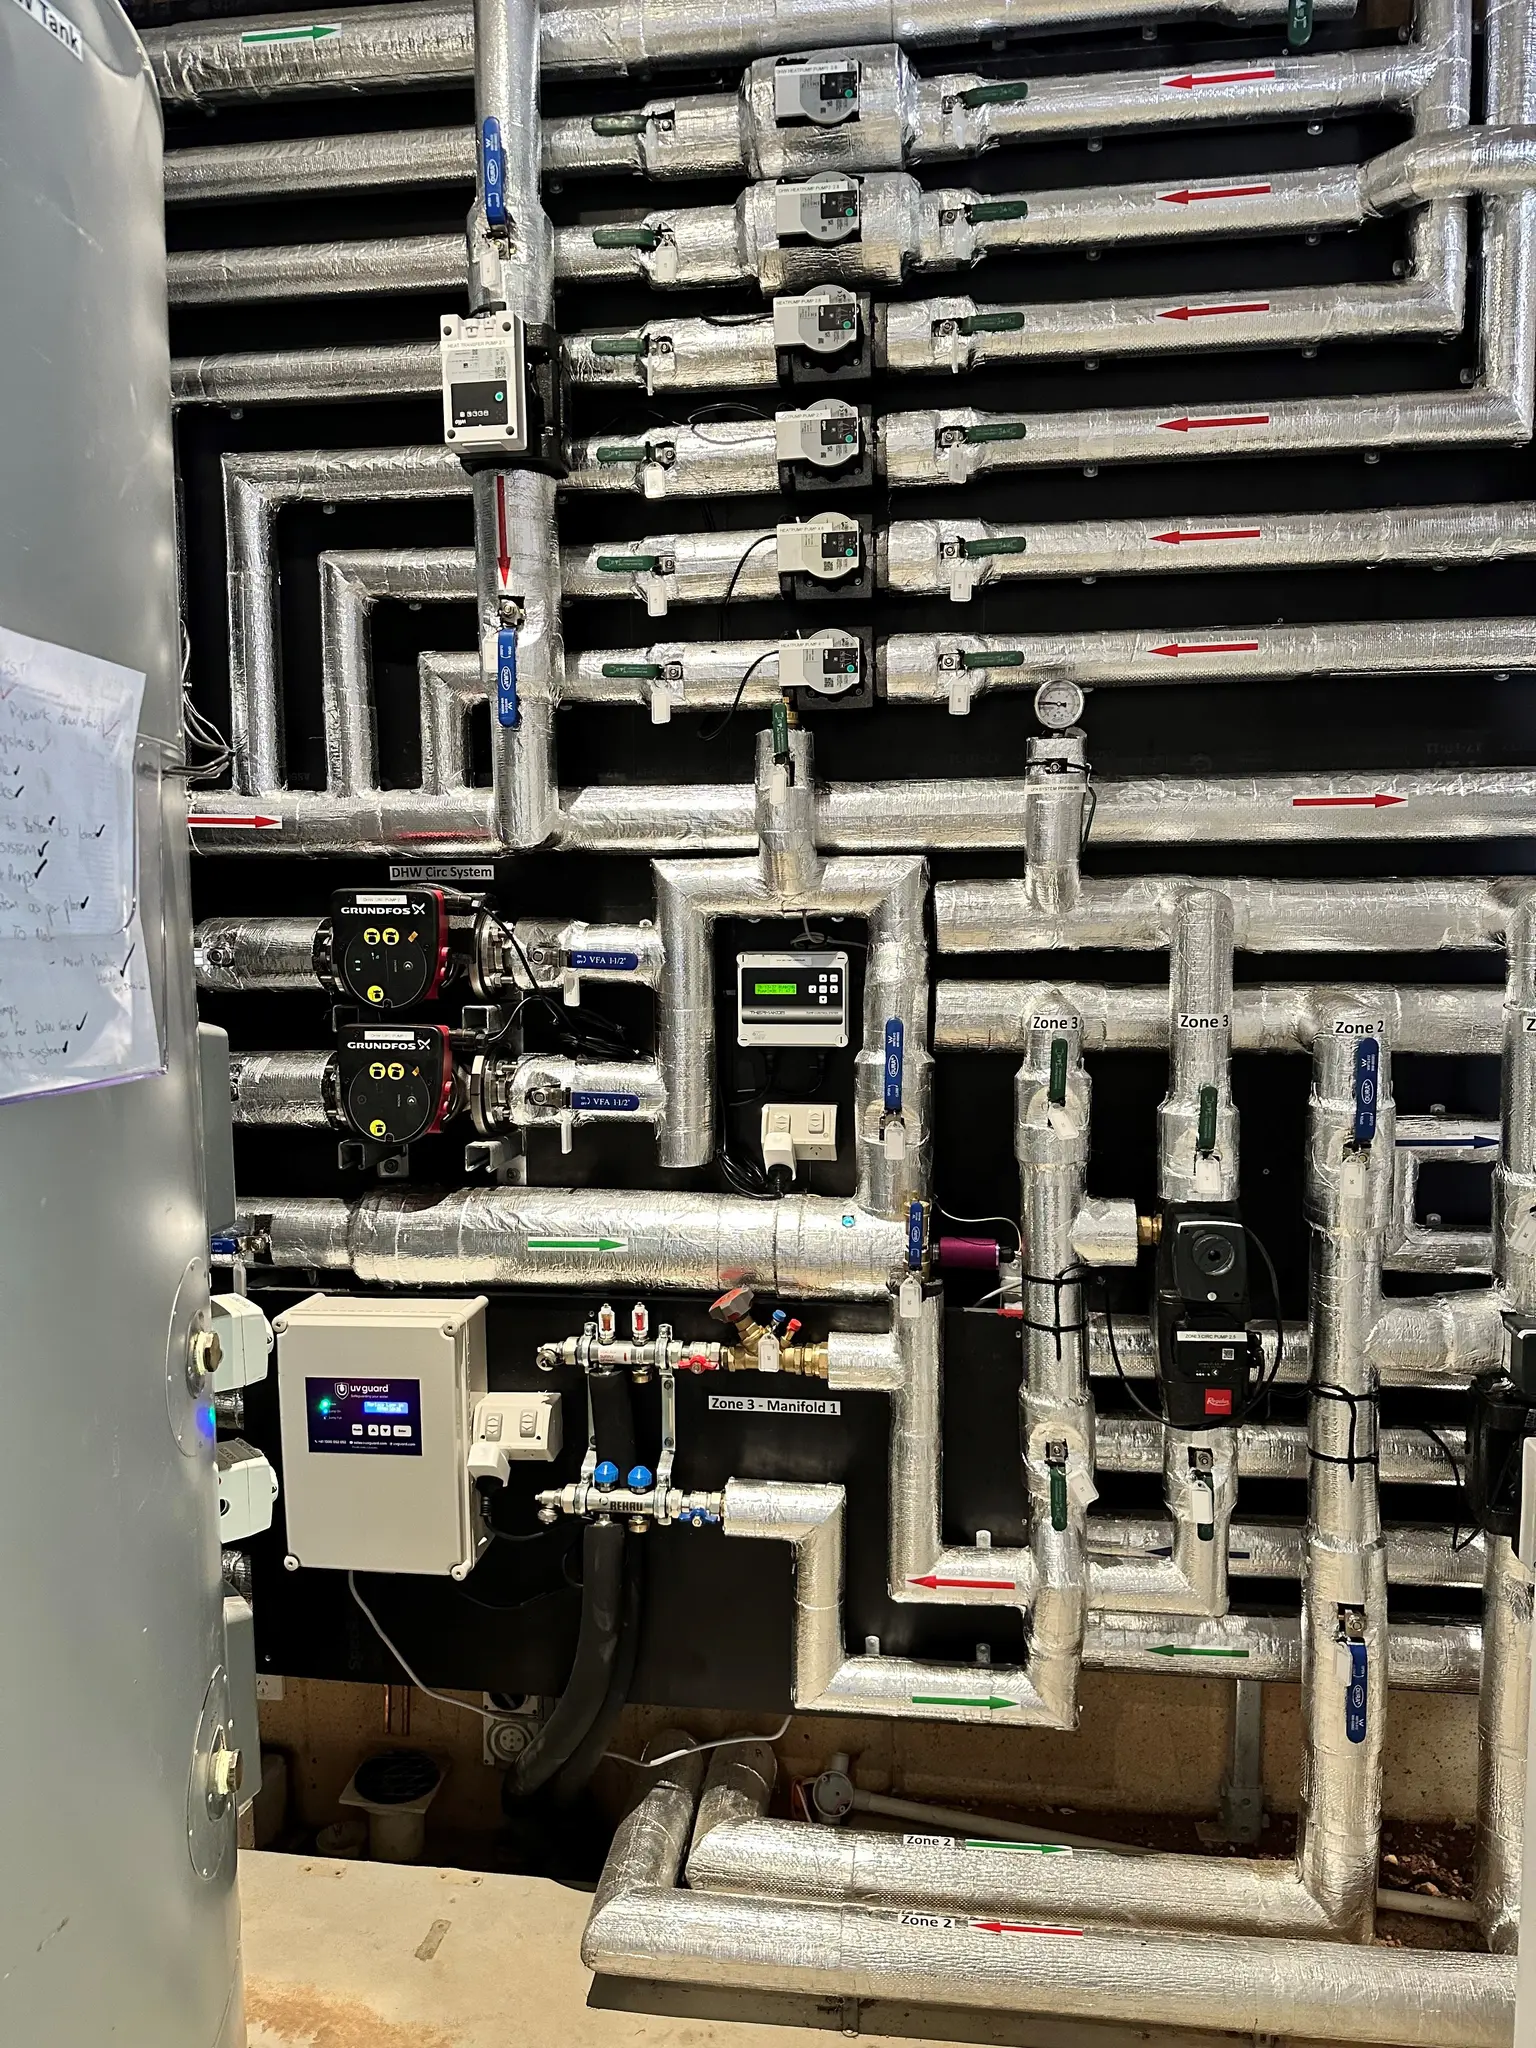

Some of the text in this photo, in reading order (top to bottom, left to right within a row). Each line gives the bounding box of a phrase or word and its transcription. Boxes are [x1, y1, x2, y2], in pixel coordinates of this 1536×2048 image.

[40, 0, 80, 55] Tank
[391, 865, 493, 880] DHW Circ System
[340, 907, 411, 915] GRUNDFOS
[589, 956, 606, 964] VFA
[1033, 1016, 1078, 1029] Zone 3
[1180, 1014, 1229, 1028] Zone 3
[1335, 1020, 1384, 1034] Zone 2
[347, 1042, 417, 1050] GRUNDFOS
[593, 1098, 610, 1106] VFA
[711, 1397, 744, 1410] Zone
[747, 1399, 755, 1410] 3
[767, 1400, 826, 1413] Manifold
[830, 1403, 837, 1413] 1
[610, 1501, 643, 1511] REHAU
[906, 1835, 951, 1847] Zone 2
[900, 1915, 952, 1929] Zone 2
